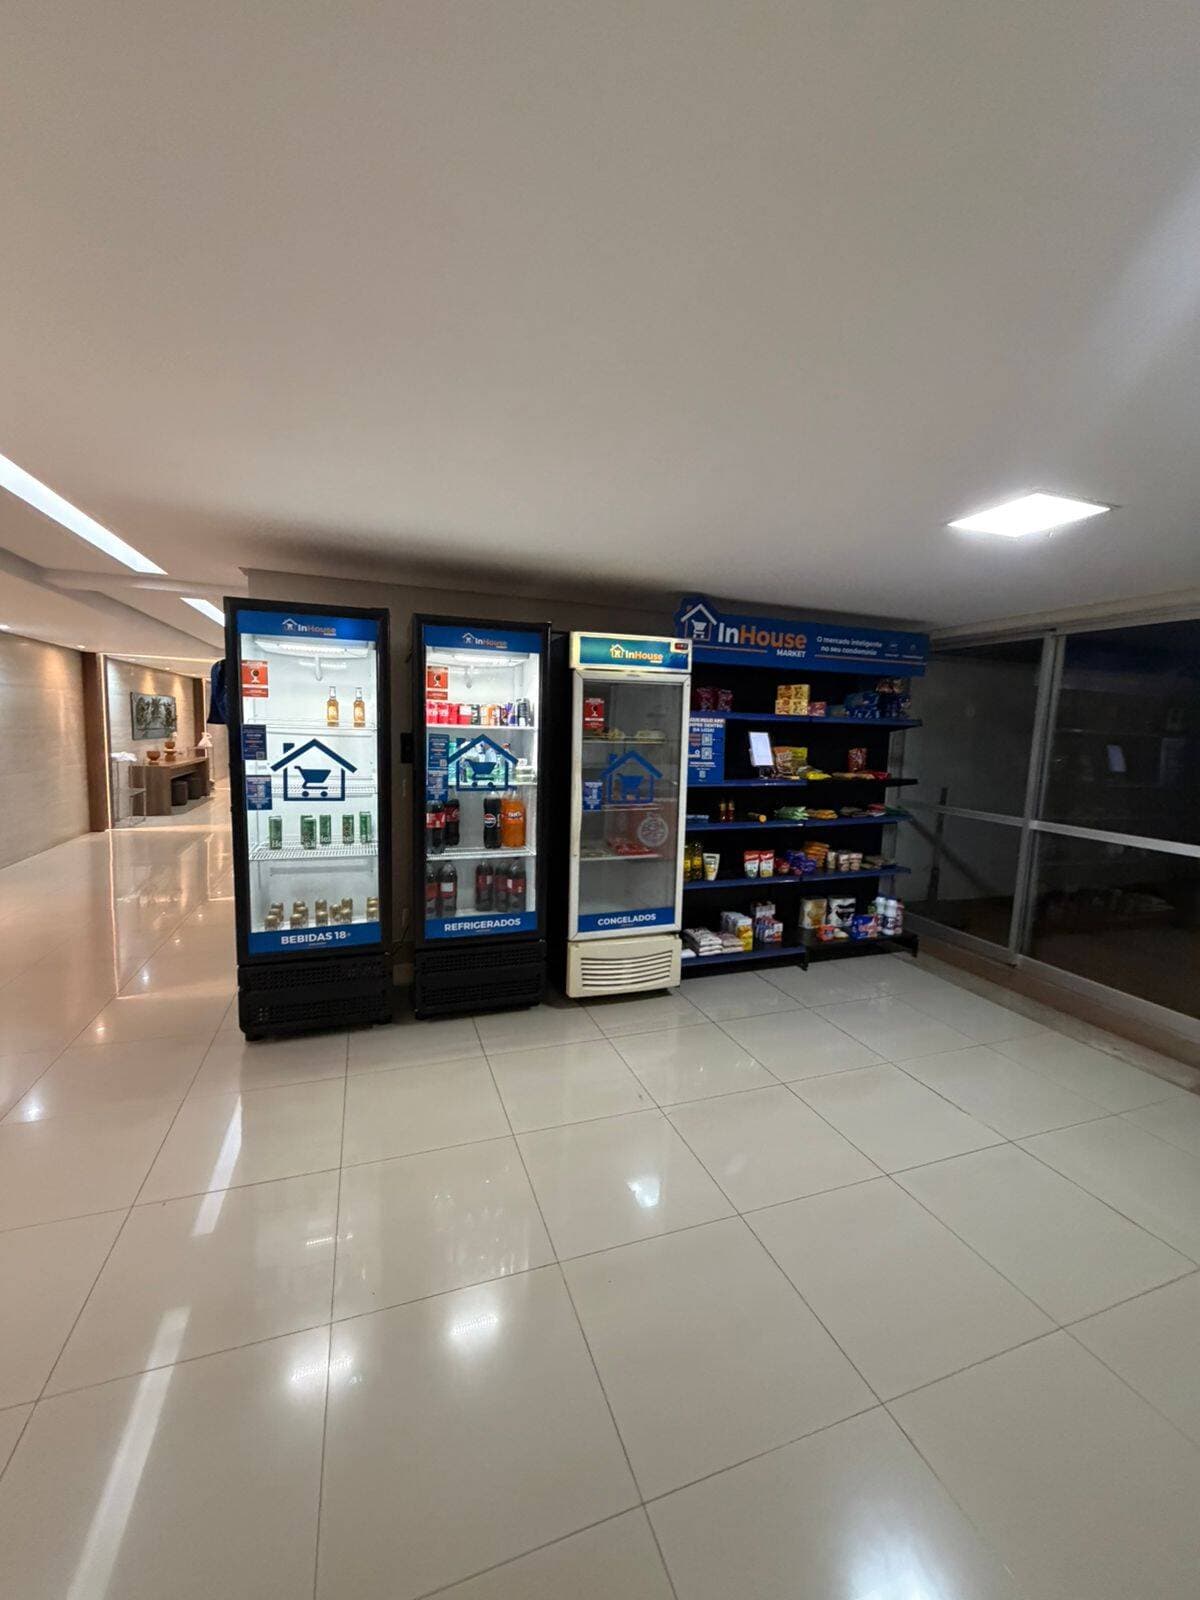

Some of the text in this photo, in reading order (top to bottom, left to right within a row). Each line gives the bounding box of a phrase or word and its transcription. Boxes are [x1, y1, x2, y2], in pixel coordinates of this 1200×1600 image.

[297, 624, 337, 635] InHouse
[717, 622, 807, 650] InHouse
[625, 650, 664, 661] InHouse
[776, 648, 807, 658] MARKET
[443, 918, 522, 932] REFRIGERADOS
[597, 913, 657, 926] CONGELADOS
[280, 931, 333, 945] BEBIDAS
